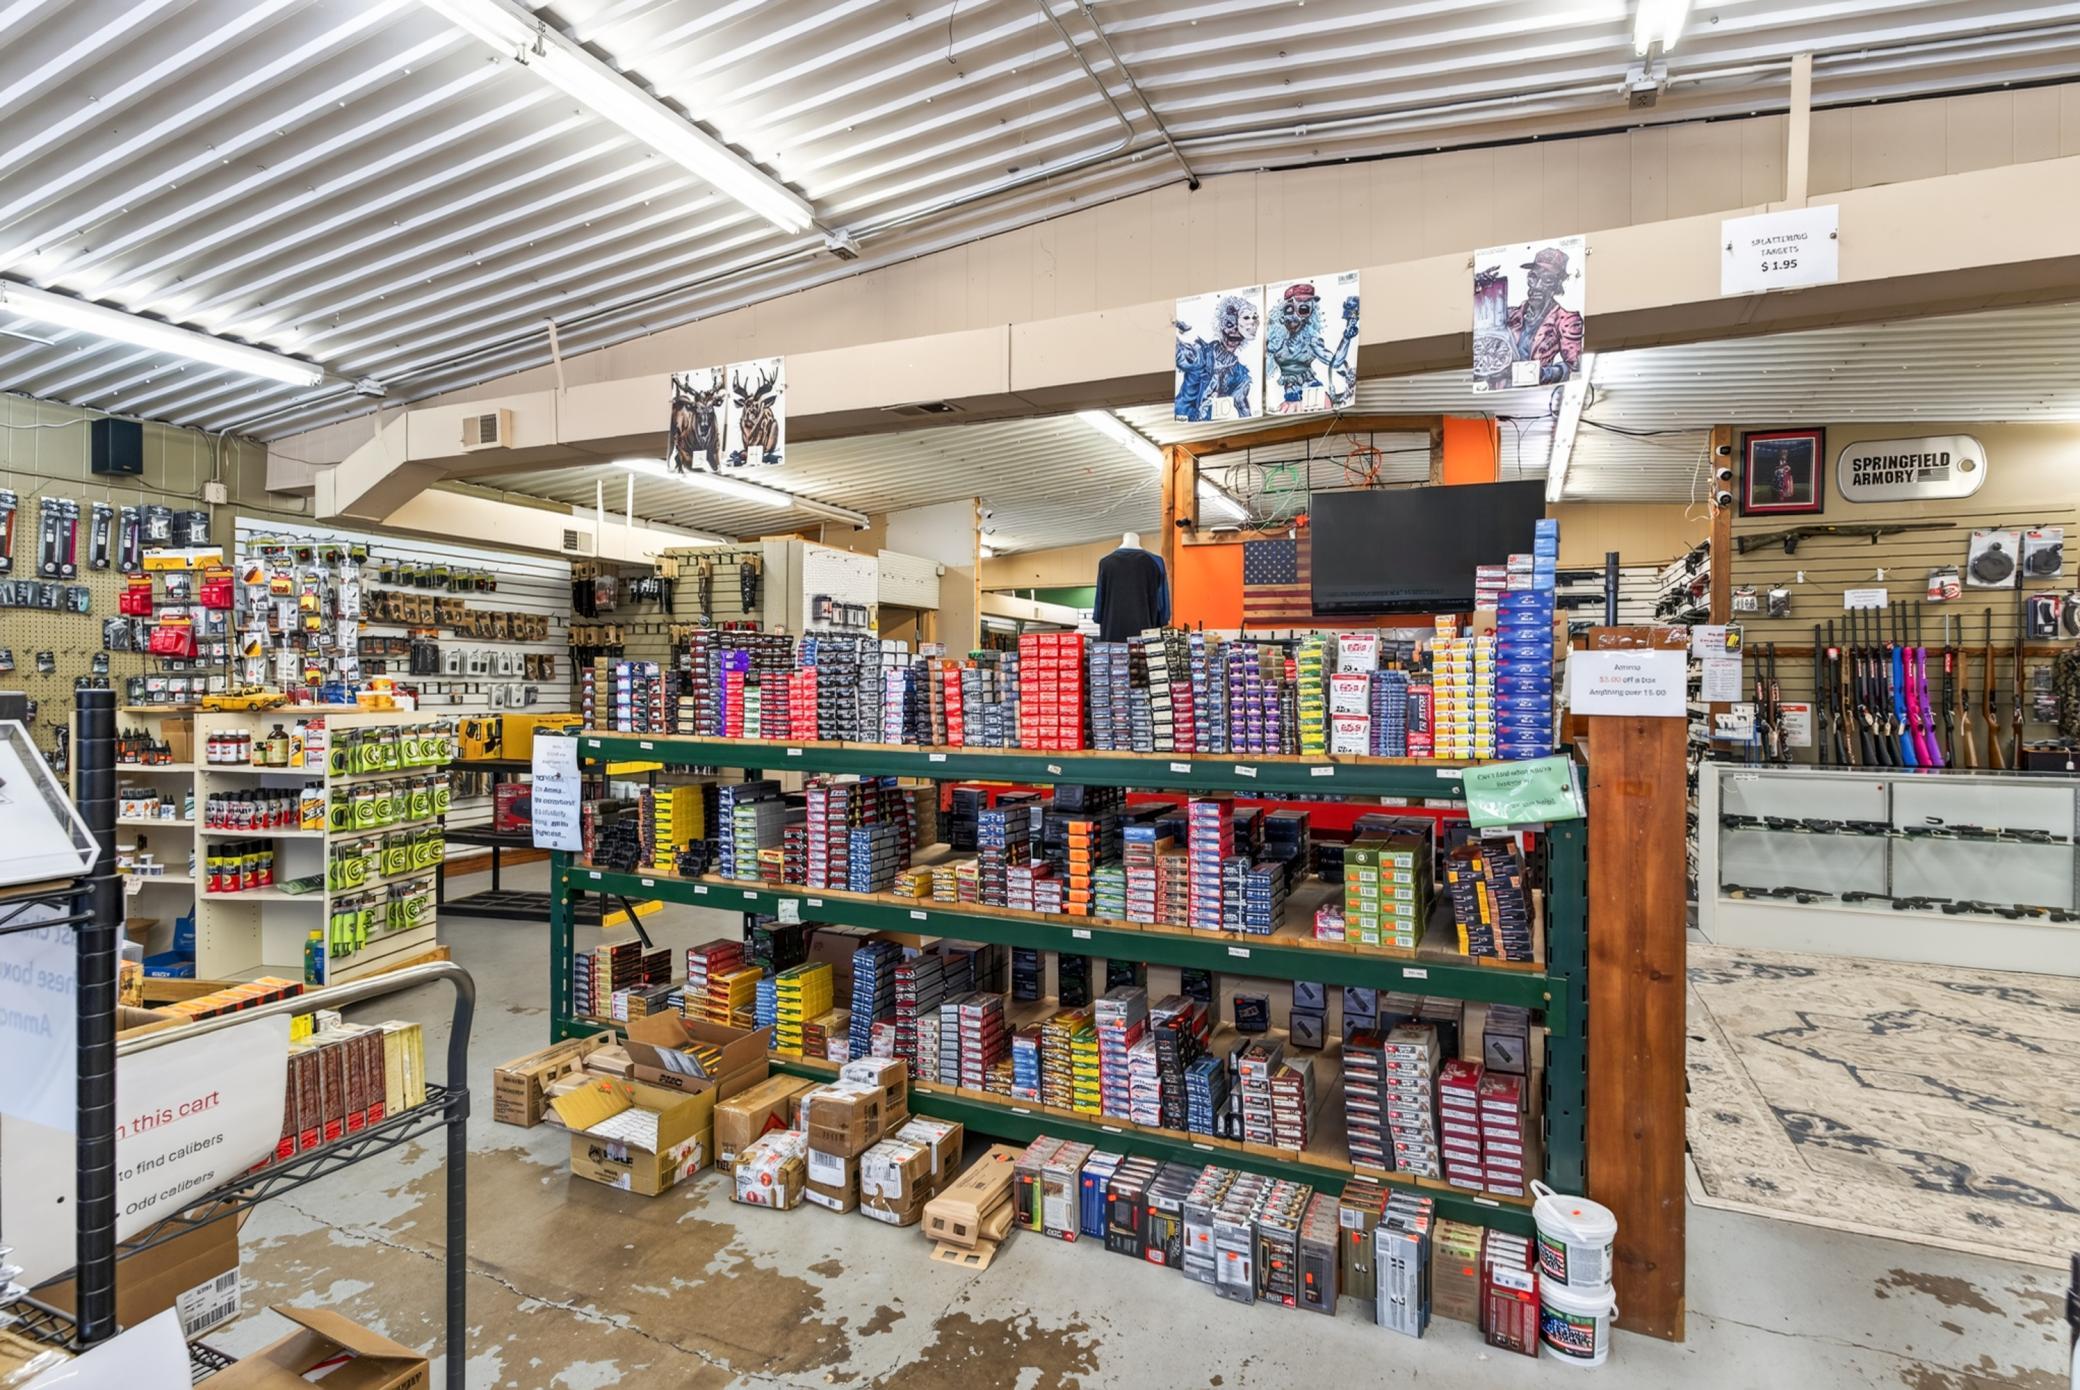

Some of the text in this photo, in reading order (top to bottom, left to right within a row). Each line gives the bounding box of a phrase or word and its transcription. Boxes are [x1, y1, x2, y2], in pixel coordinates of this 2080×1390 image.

[1772, 259, 1798, 271] 1.95
[1852, 452, 1951, 472] SPRINGFIELD
[1852, 469, 1914, 486] ARMORY
[132, 1109, 173, 1134] this
[179, 1091, 219, 1117] cart
[118, 1133, 224, 1181] to find calibers
[126, 1170, 215, 1215] Odd calibers
